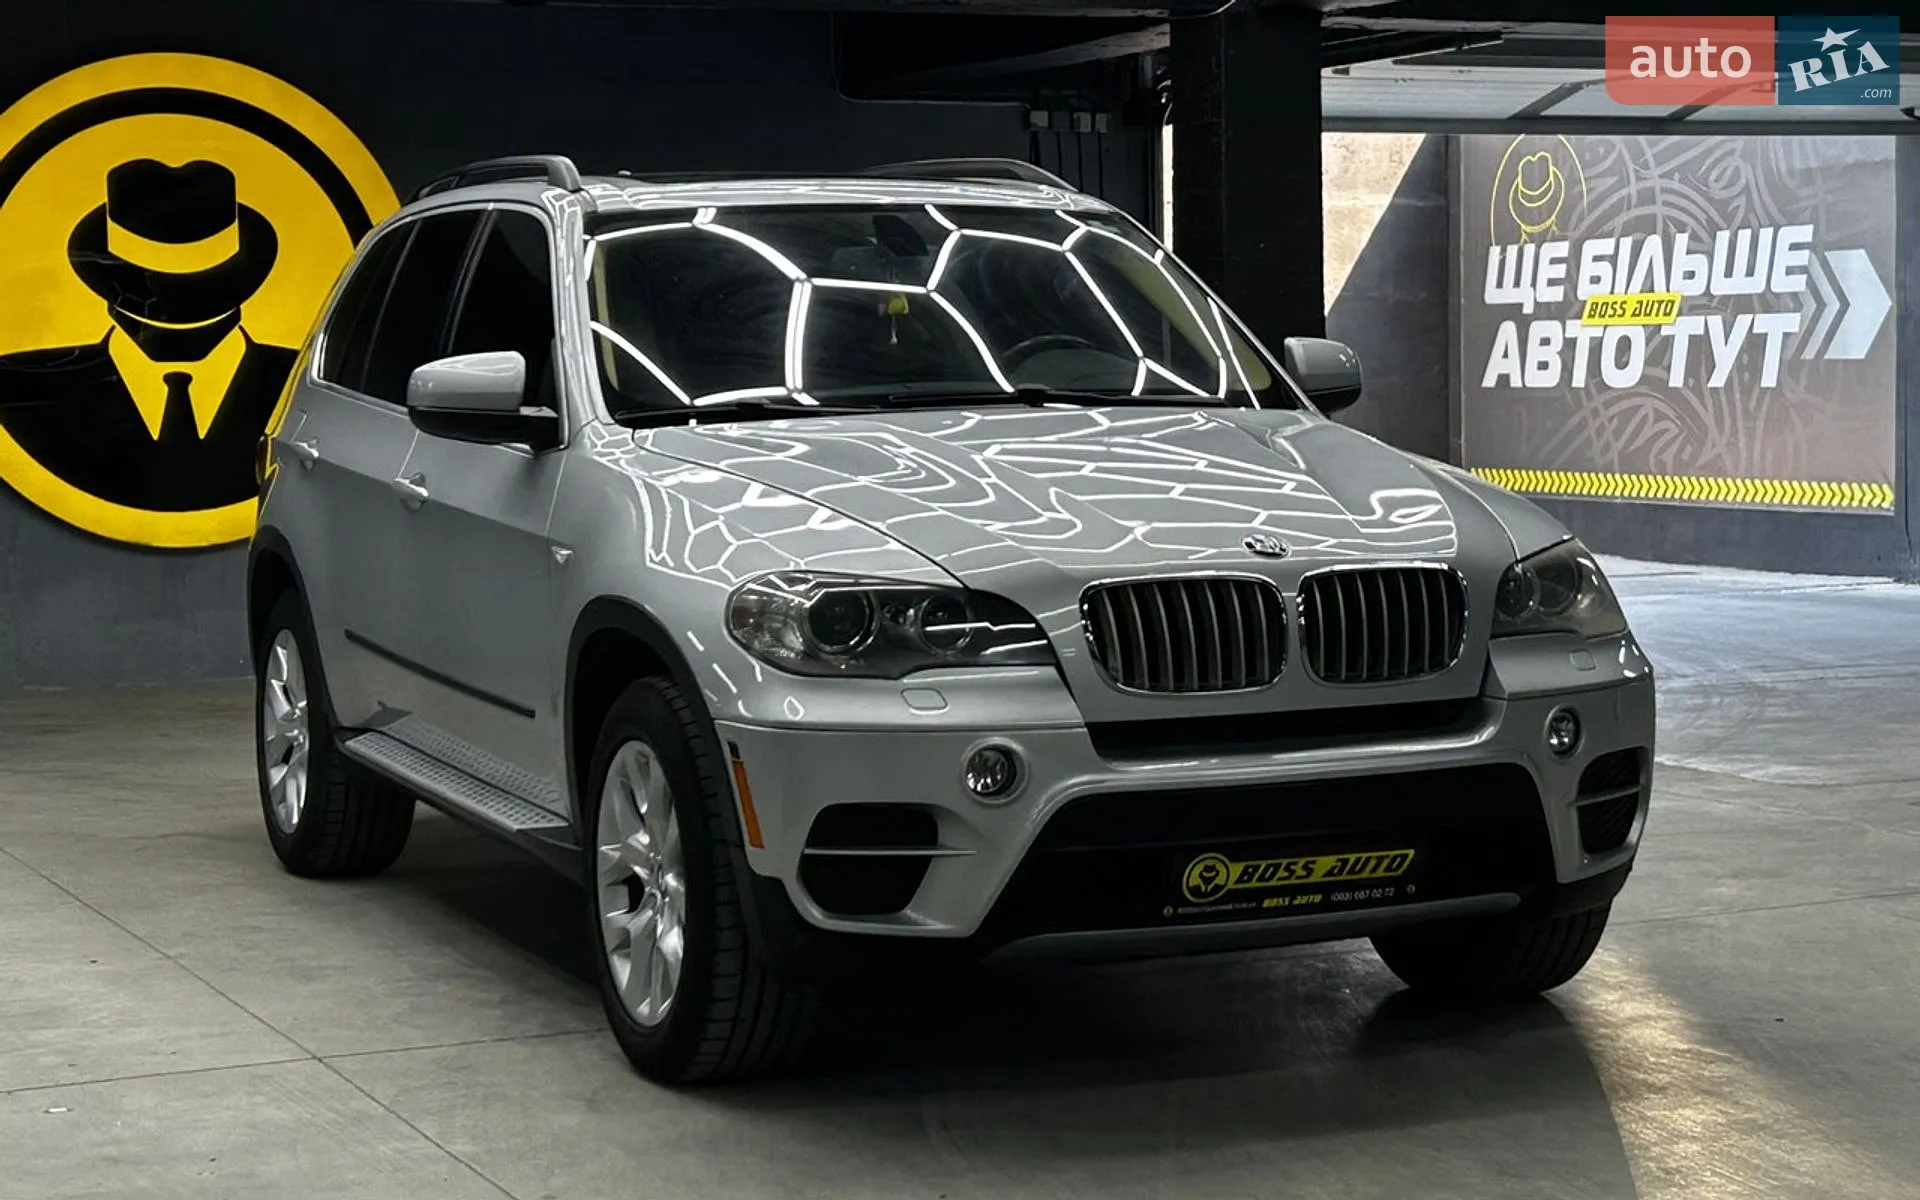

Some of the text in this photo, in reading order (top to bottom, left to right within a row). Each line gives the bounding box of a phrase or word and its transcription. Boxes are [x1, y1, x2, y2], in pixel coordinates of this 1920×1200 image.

[1484, 224, 1815, 315] ЩЕ БІЛЬШЕ
[1587, 298, 1676, 320] BOSS AUTO
[1481, 311, 1801, 389] АВТО ТУТ
[1233, 852, 1409, 885] BOSS AUTO
